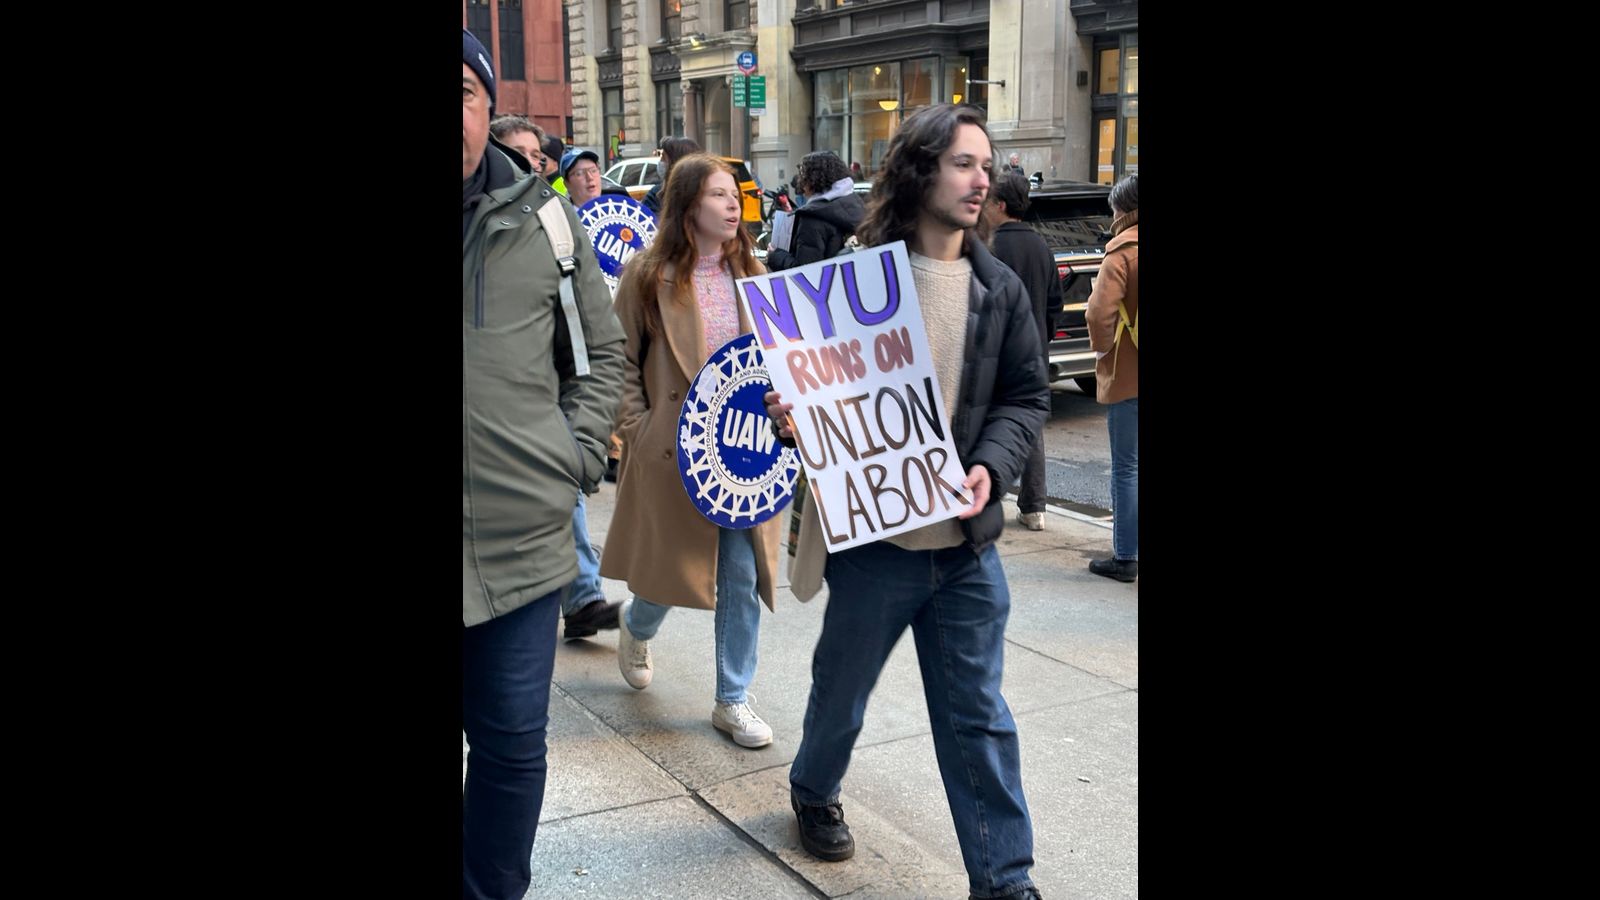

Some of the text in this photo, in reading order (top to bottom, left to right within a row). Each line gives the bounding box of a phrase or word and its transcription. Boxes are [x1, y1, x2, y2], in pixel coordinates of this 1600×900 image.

[743, 250, 901, 349] NYU
[739, 370, 752, 379] AND
[786, 326, 914, 395] RUNS ON
[713, 377, 738, 407] AEROSPACE
[722, 407, 776, 455] UAW
[787, 377, 945, 470] UNION
[709, 457, 723, 480] UNITED
[810, 447, 972, 545] LABOR
